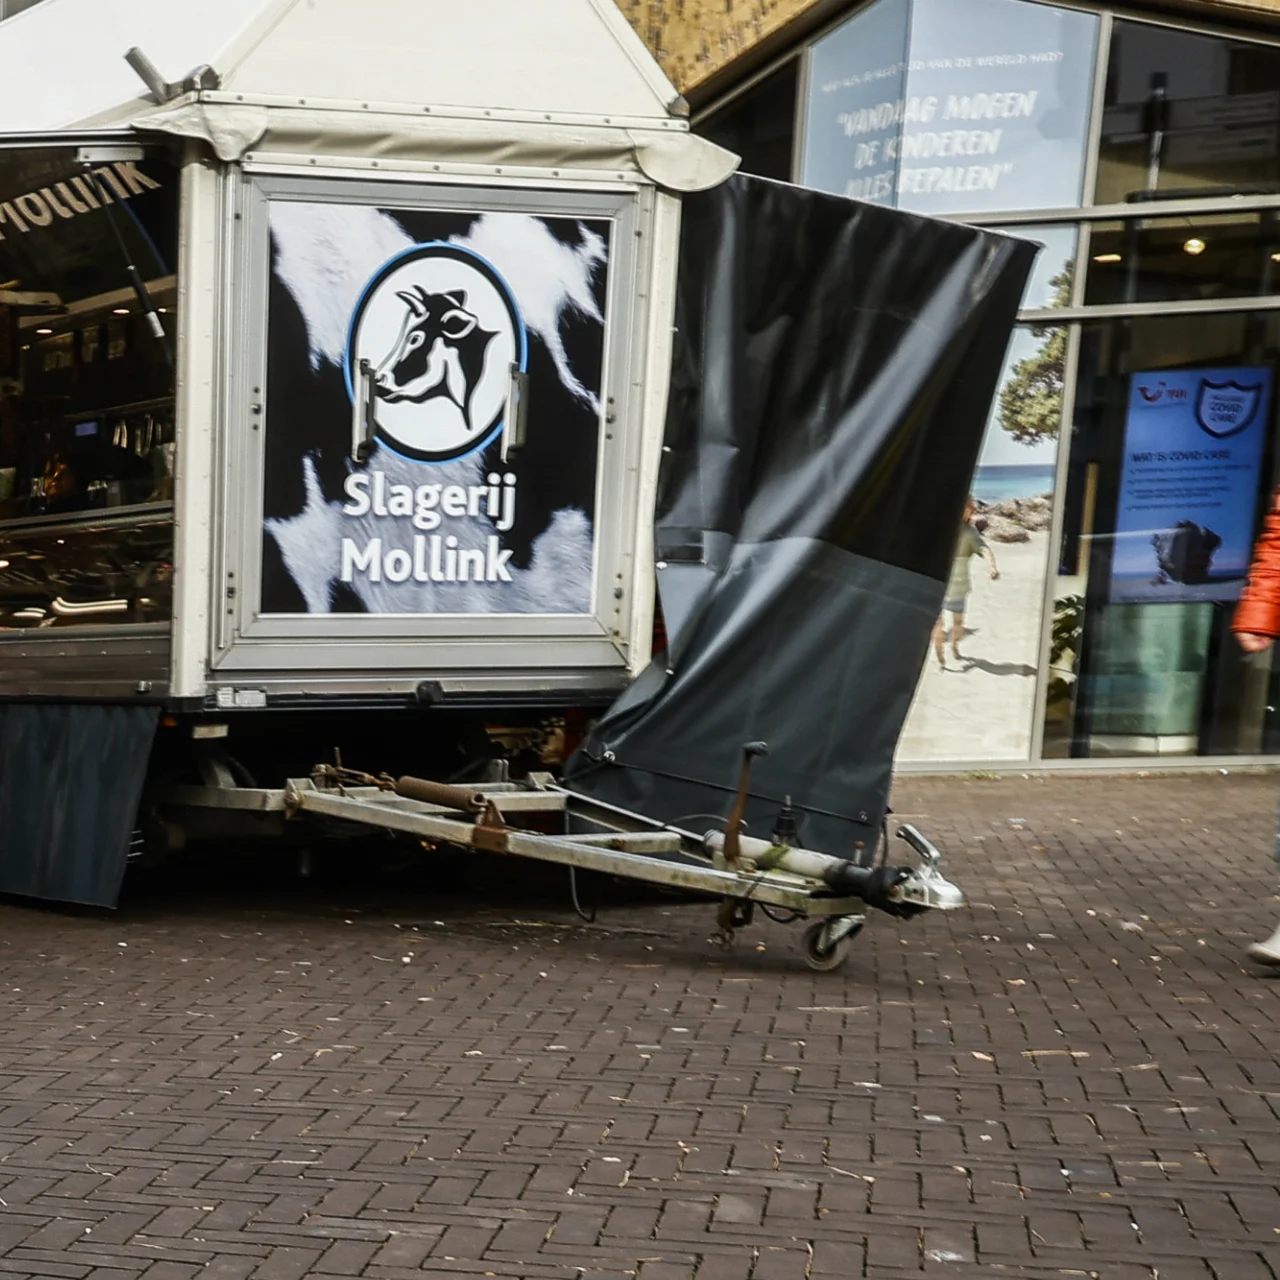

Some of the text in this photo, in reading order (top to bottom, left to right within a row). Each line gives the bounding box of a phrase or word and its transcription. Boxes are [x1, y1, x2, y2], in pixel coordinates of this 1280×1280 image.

[943, 90, 1038, 120] MOGEN
[854, 129, 1003, 169] DE KINDEREN
[343, 471, 517, 531] Slagerij
[342, 535, 513, 582] Mollink
